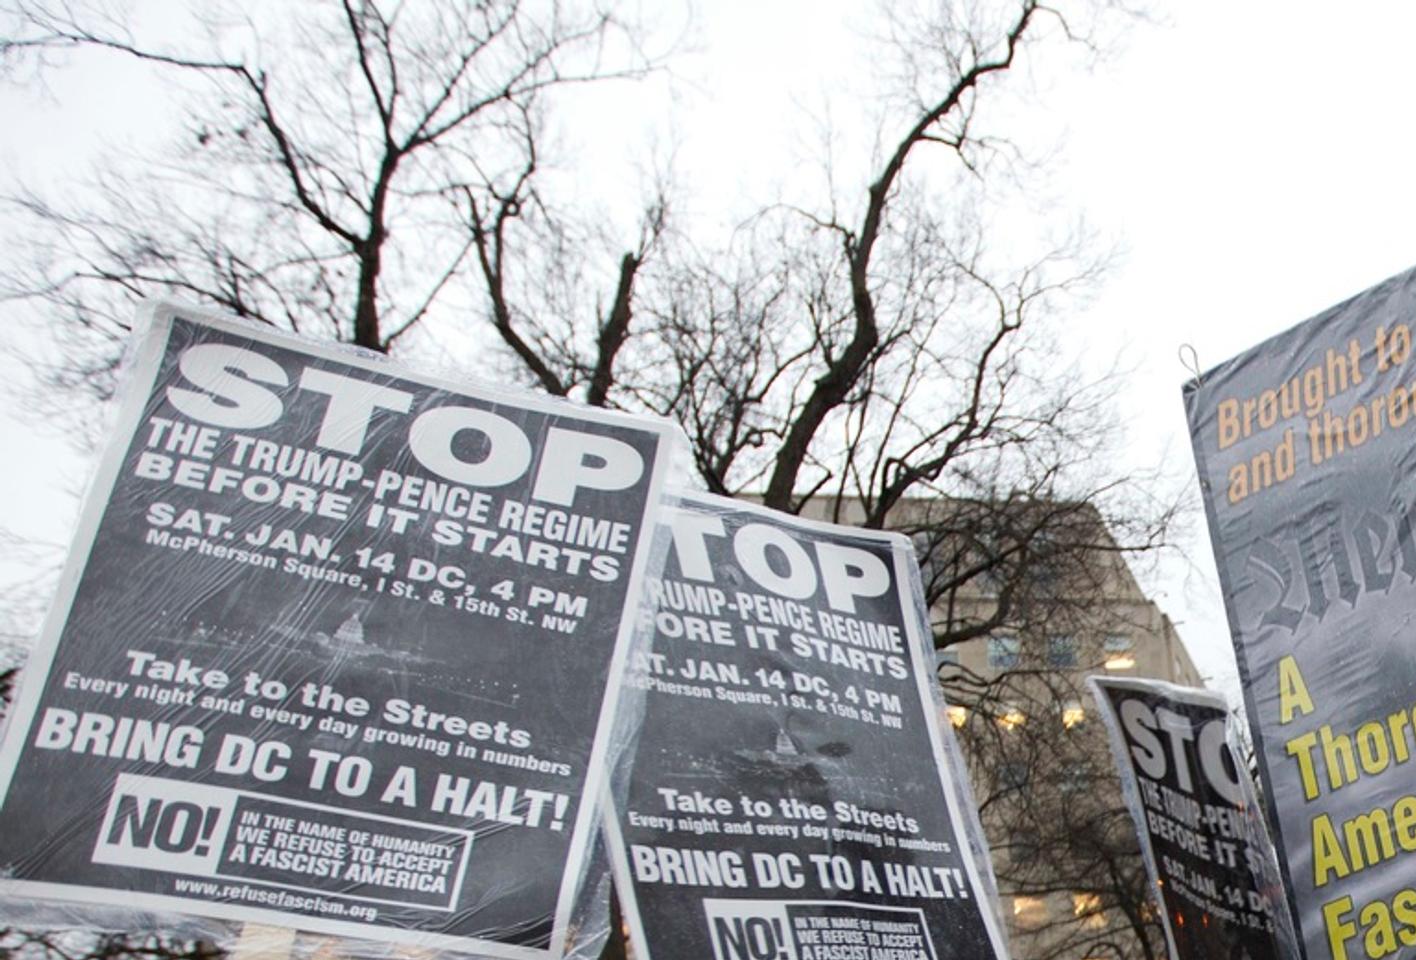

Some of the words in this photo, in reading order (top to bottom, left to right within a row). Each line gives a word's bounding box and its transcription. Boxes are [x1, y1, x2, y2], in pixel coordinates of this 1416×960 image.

[1216, 340, 1363, 452] Brought
[1372, 315, 1413, 374] to
[167, 342, 644, 506] STOP
[141, 416, 220, 459] THE
[222, 434, 494, 523] TRUMP-PENCE
[497, 499, 631, 554] REGIME
[1226, 430, 1296, 508] and
[131, 451, 353, 520] BEFORE
[365, 503, 420, 536] IT
[429, 519, 622, 583] STARTS
[144, 501, 238, 540] SAT.
[242, 522, 344, 562] JAN.
[352, 546, 398, 575] 14
[406, 558, 479, 596] DC,
[489, 577, 517, 600] 4
[526, 586, 588, 617] PM
[144, 529, 279, 570] McPherson
[281, 557, 371, 591] Square,
[375, 577, 387, 592] I
[389, 580, 423, 601] St.
[428, 589, 446, 606] &
[451, 594, 501, 617] 15th
[505, 606, 536, 625] St.
[541, 614, 577, 634] NW
[662, 515, 890, 614] TOP
[654, 579, 818, 635] RUMP-PENCE
[817, 611, 905, 654] REGIME
[744, 624, 780, 651] IT
[790, 633, 908, 680] STARTS
[120, 649, 233, 691] Take
[240, 672, 289, 702] to
[297, 682, 373, 718] the
[380, 698, 534, 749] Streets
[681, 658, 749, 686] JAN.
[755, 668, 786, 689] 14
[792, 671, 838, 702] DC,
[845, 686, 859, 704] 4
[865, 689, 902, 713] PM
[715, 686, 779, 707] Square,
[792, 694, 812, 710] St.
[816, 699, 827, 713] &
[831, 701, 858, 721] 15th
[861, 708, 879, 724] St.
[1278, 654, 1316, 725] A
[62, 671, 130, 698] Every
[131, 682, 195, 710] night
[198, 693, 245, 716] and
[247, 703, 314, 731] every
[315, 716, 360, 739] day
[361, 725, 452, 757] growing
[455, 741, 478, 759] in
[480, 746, 573, 777] numbers
[1120, 699, 1243, 808] STO
[32, 704, 207, 771] BRING
[212, 733, 294, 785] DC
[298, 749, 374, 799] TO
[380, 765, 424, 806] A
[431, 774, 570, 831] HALT!
[105, 793, 222, 858] NO!
[240, 810, 260, 825] IN
[262, 814, 296, 832] THE
[297, 821, 346, 841] NAME
[347, 830, 370, 845] OF
[370, 833, 456, 860] HUMANITY
[628, 811, 676, 832] Every
[679, 815, 719, 834] night
[724, 820, 753, 835] and
[757, 823, 798, 839] every
[802, 822, 829, 840] day
[832, 827, 883, 847] growing
[885, 832, 896, 846] in
[899, 836, 951, 853] numbers
[658, 787, 733, 816] Take
[740, 796, 772, 818] to
[779, 797, 828, 821] the
[834, 800, 920, 834] Streets
[1147, 811, 1210, 861] BEFORE
[1213, 839, 1237, 868] IT
[229, 843, 253, 864] A
[248, 846, 352, 880] FASCIST
[343, 862, 448, 894] AMERICA
[234, 825, 271, 845] WE
[272, 833, 346, 859] REFUSE
[350, 846, 377, 864] TO
[378, 850, 453, 875] ACCEPT
[630, 845, 747, 888] BRING
[752, 853, 805, 889] DC
[810, 854, 855, 891] TO
[861, 860, 883, 895] A
[886, 862, 968, 899] HALT!
[171, 876, 380, 921] www.refusefascism.org
[1224, 885, 1244, 908] 14
[802, 946, 814, 960] A
[868, 932, 881, 946] TO
